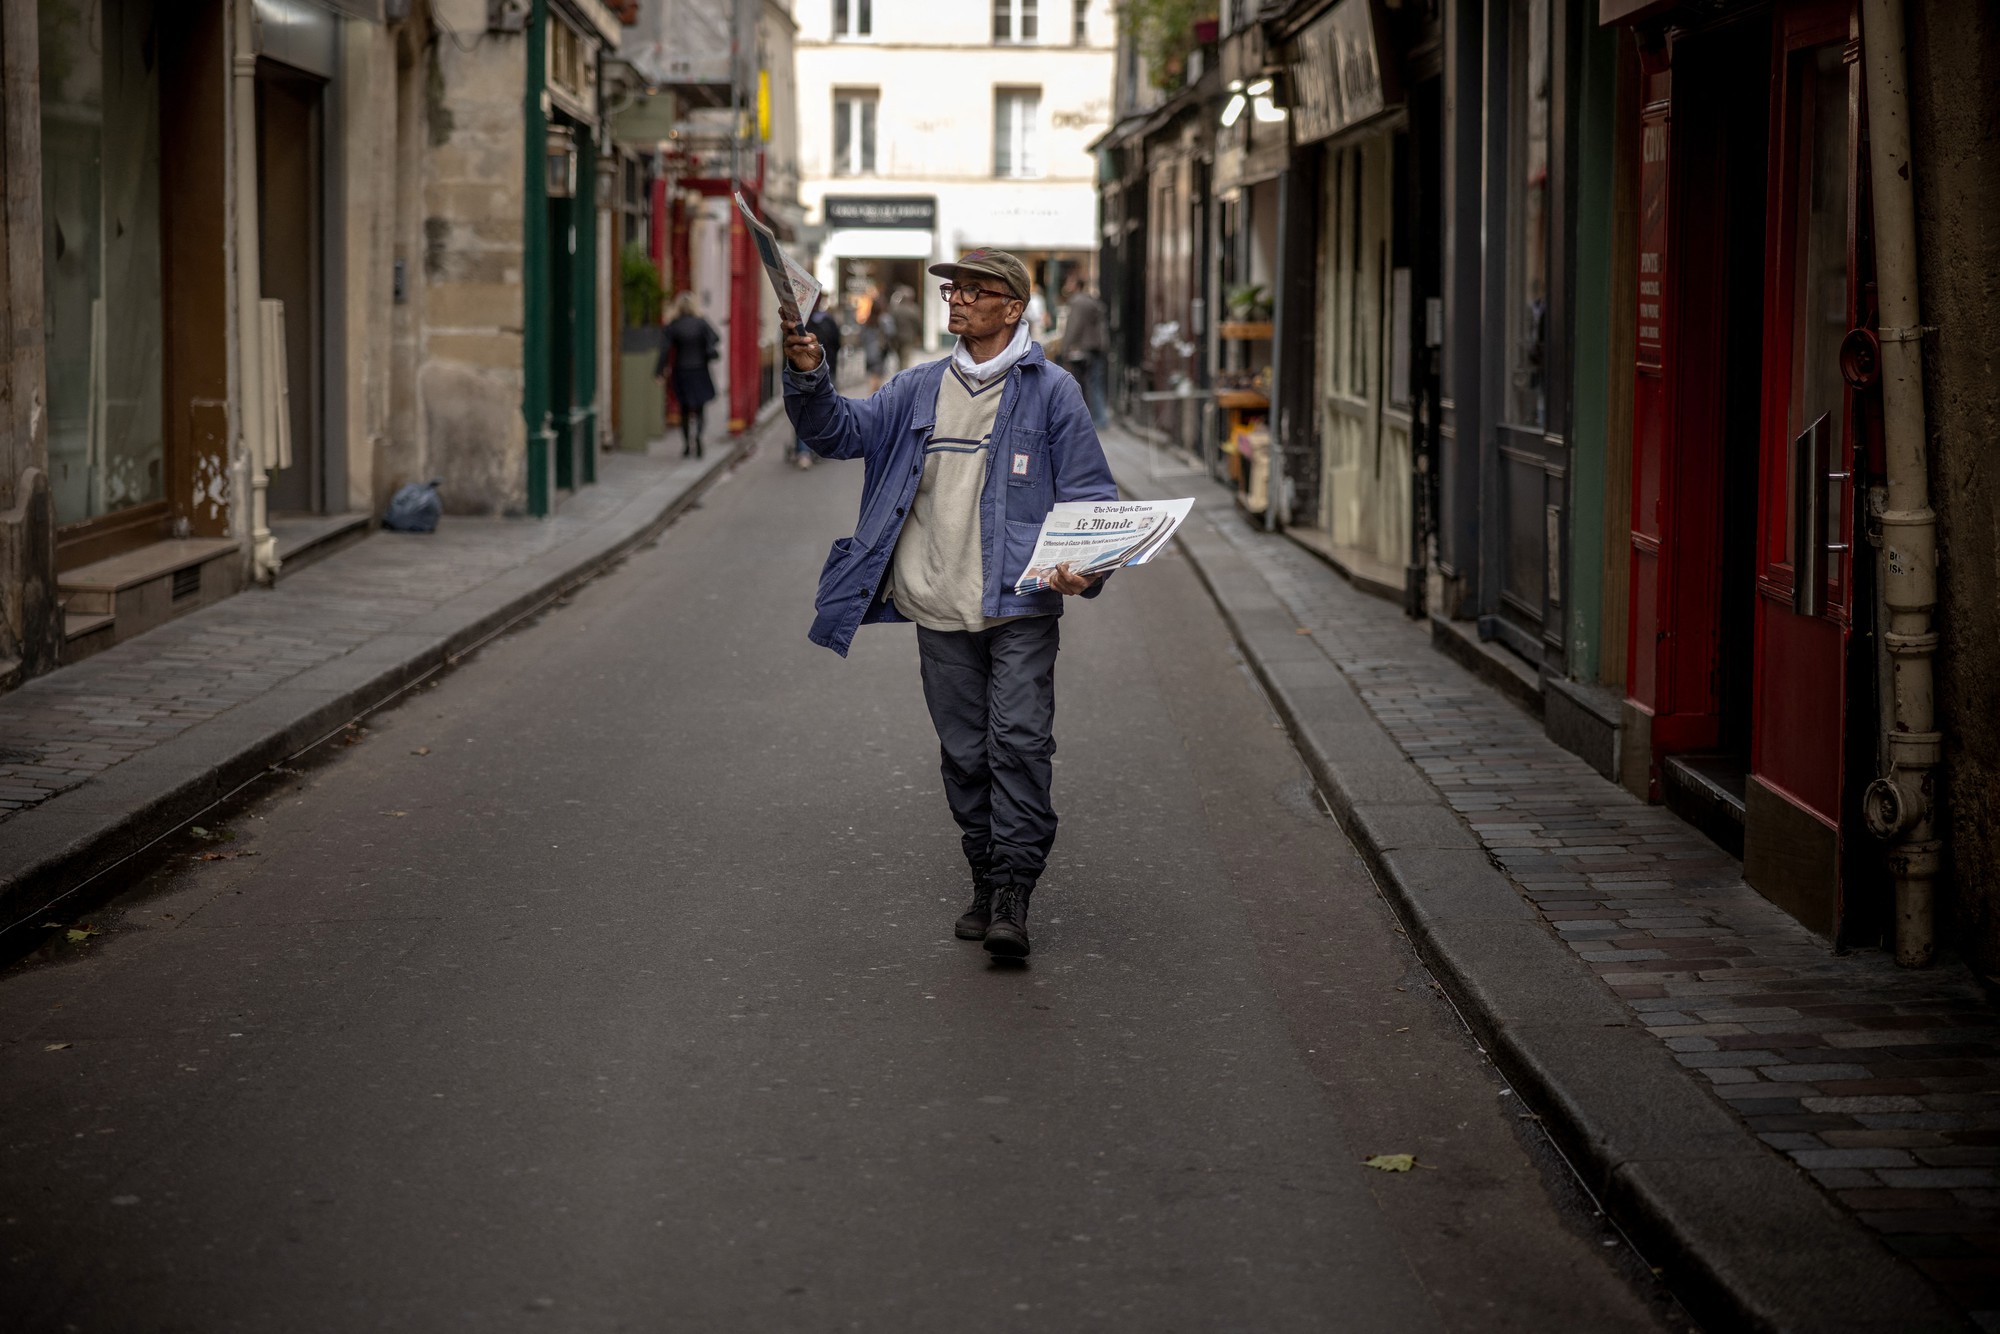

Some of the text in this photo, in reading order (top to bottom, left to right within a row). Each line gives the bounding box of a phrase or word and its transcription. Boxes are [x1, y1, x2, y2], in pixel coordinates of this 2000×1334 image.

[1119, 505, 1134, 514] York
[1074, 518, 1088, 530] Le
[1088, 518, 1133, 530] Monde
